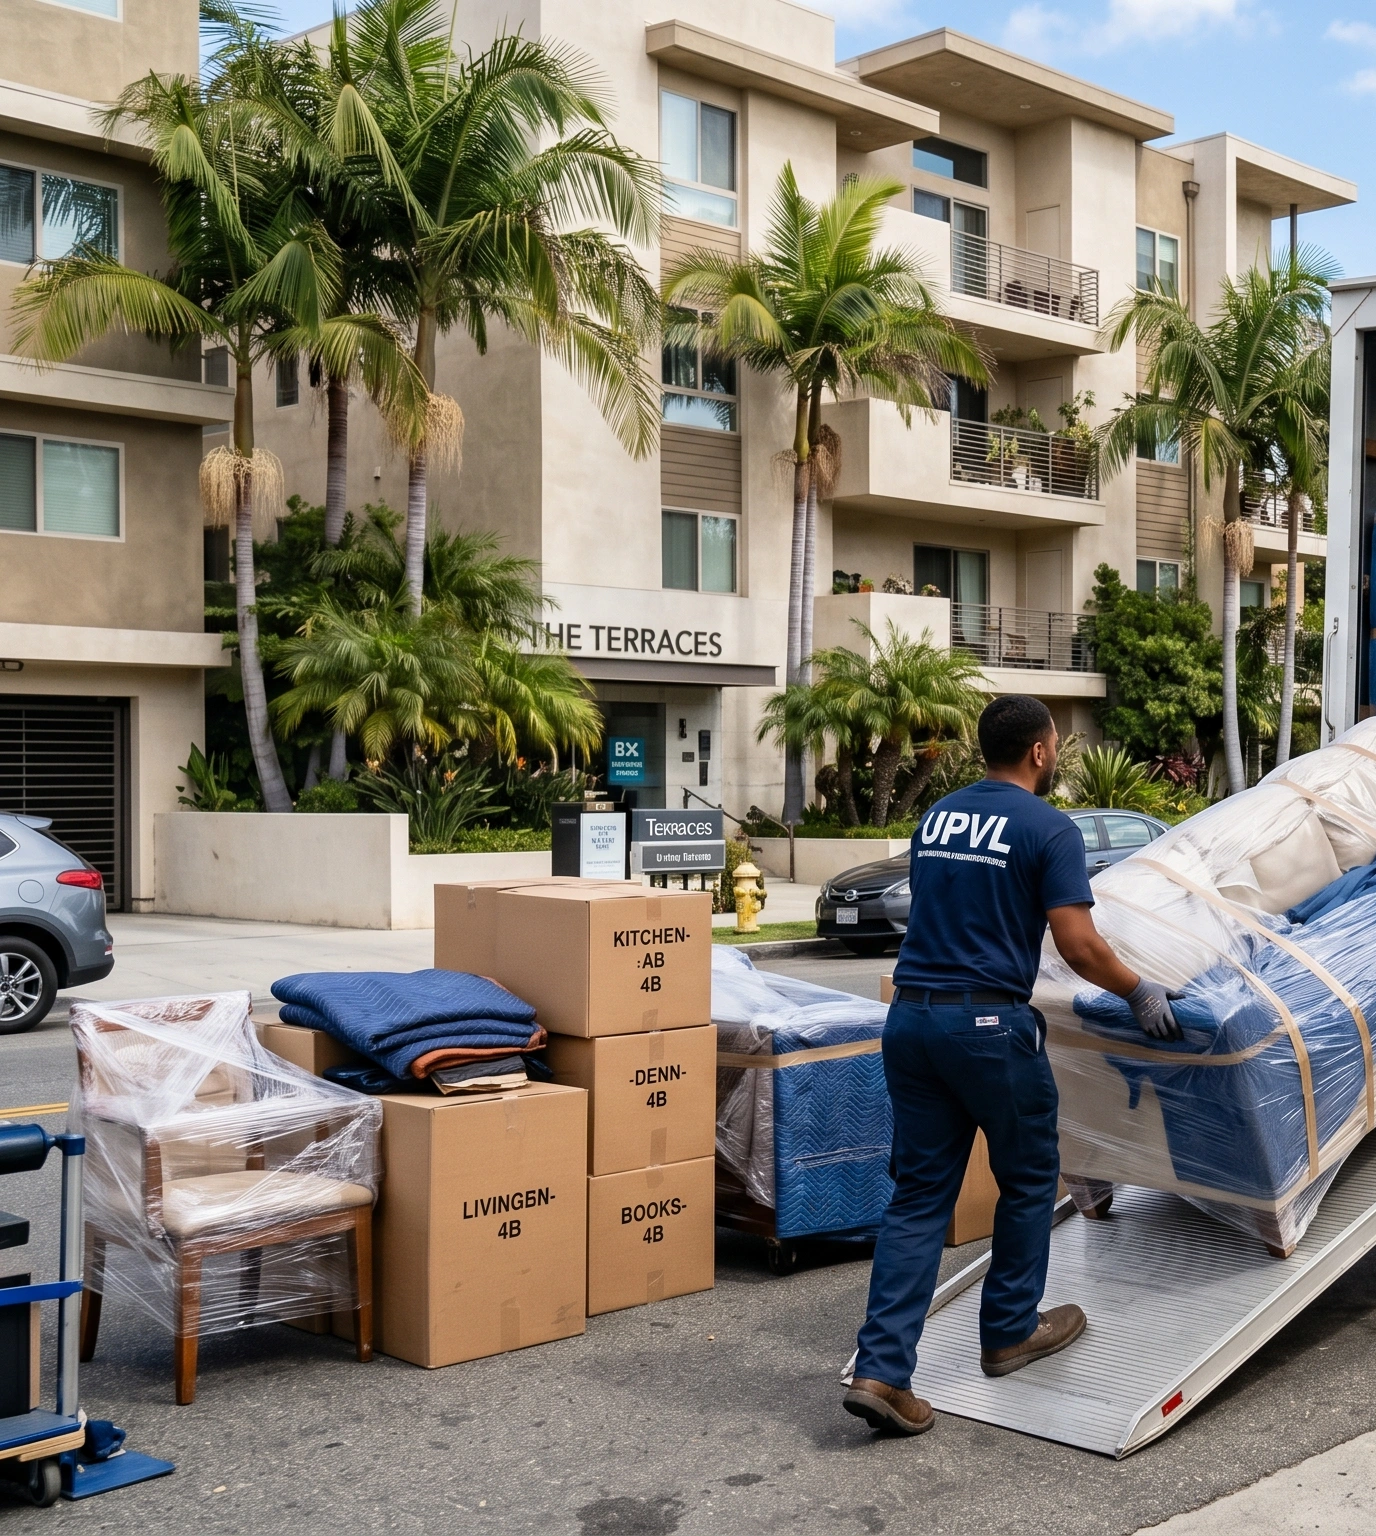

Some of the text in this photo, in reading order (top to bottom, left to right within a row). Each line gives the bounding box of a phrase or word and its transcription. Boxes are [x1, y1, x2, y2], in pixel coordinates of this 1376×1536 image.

[529, 622, 722, 657] THE TERRACES
[615, 741, 639, 757] BX
[921, 810, 1011, 854] UPVL
[613, 926, 691, 948] KITCHEN-
[640, 975, 662, 992] 4B
[629, 1064, 687, 1086] -DENN-
[646, 1090, 667, 1109] 4B
[621, 1197, 687, 1225] BOOKS-
[498, 1219, 522, 1239] 4B
[642, 1224, 664, 1244] 4B
